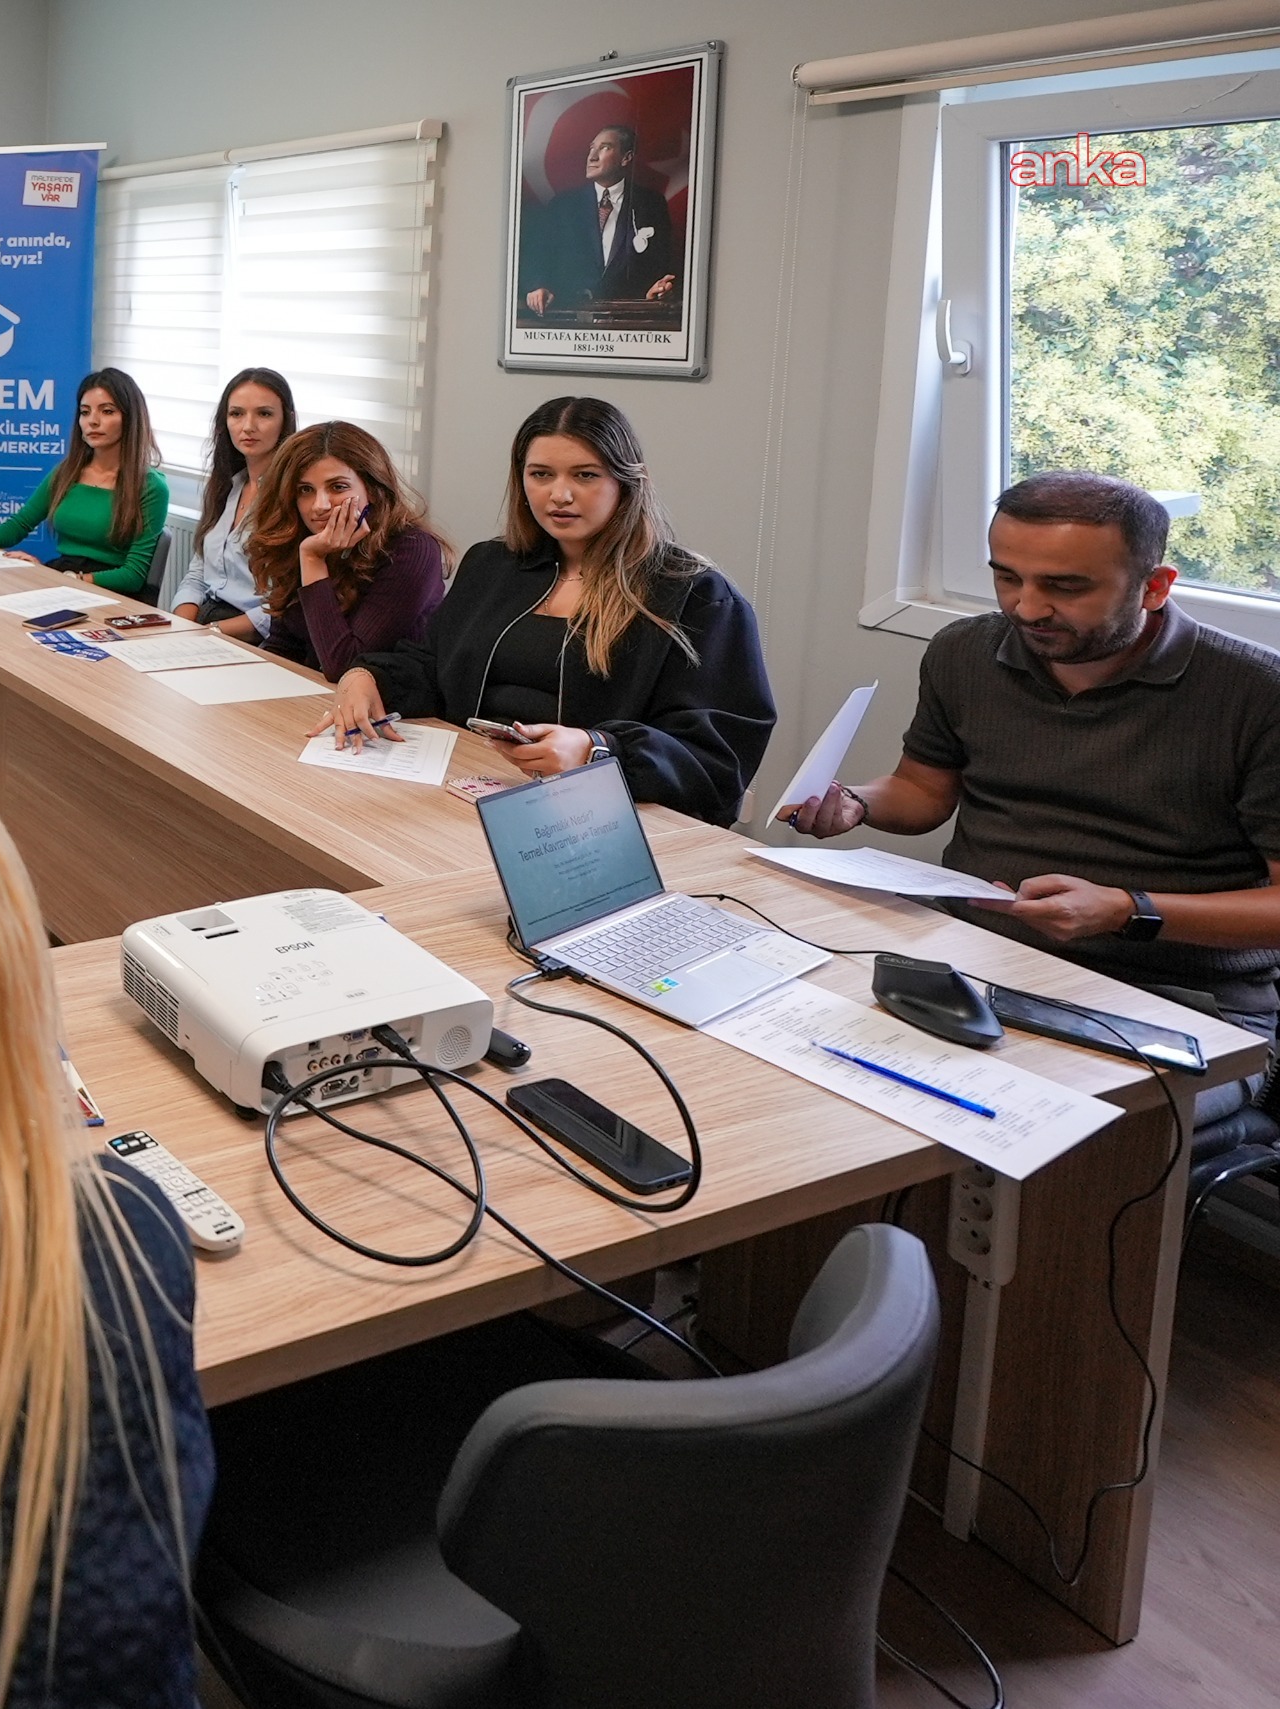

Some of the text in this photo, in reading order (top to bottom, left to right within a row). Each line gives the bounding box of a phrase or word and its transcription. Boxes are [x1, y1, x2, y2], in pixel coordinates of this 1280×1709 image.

[31, 182, 73, 194] YAŞAM
[41, 193, 60, 202] VAR
[7, 232, 71, 250] anında,
[524, 331, 672, 343] MUSTAFA KEMAL ATATÜRK
[573, 344, 614, 352] 1881-1938
[518, 845, 544, 862] Temel
[275, 940, 315, 954] EPSON
